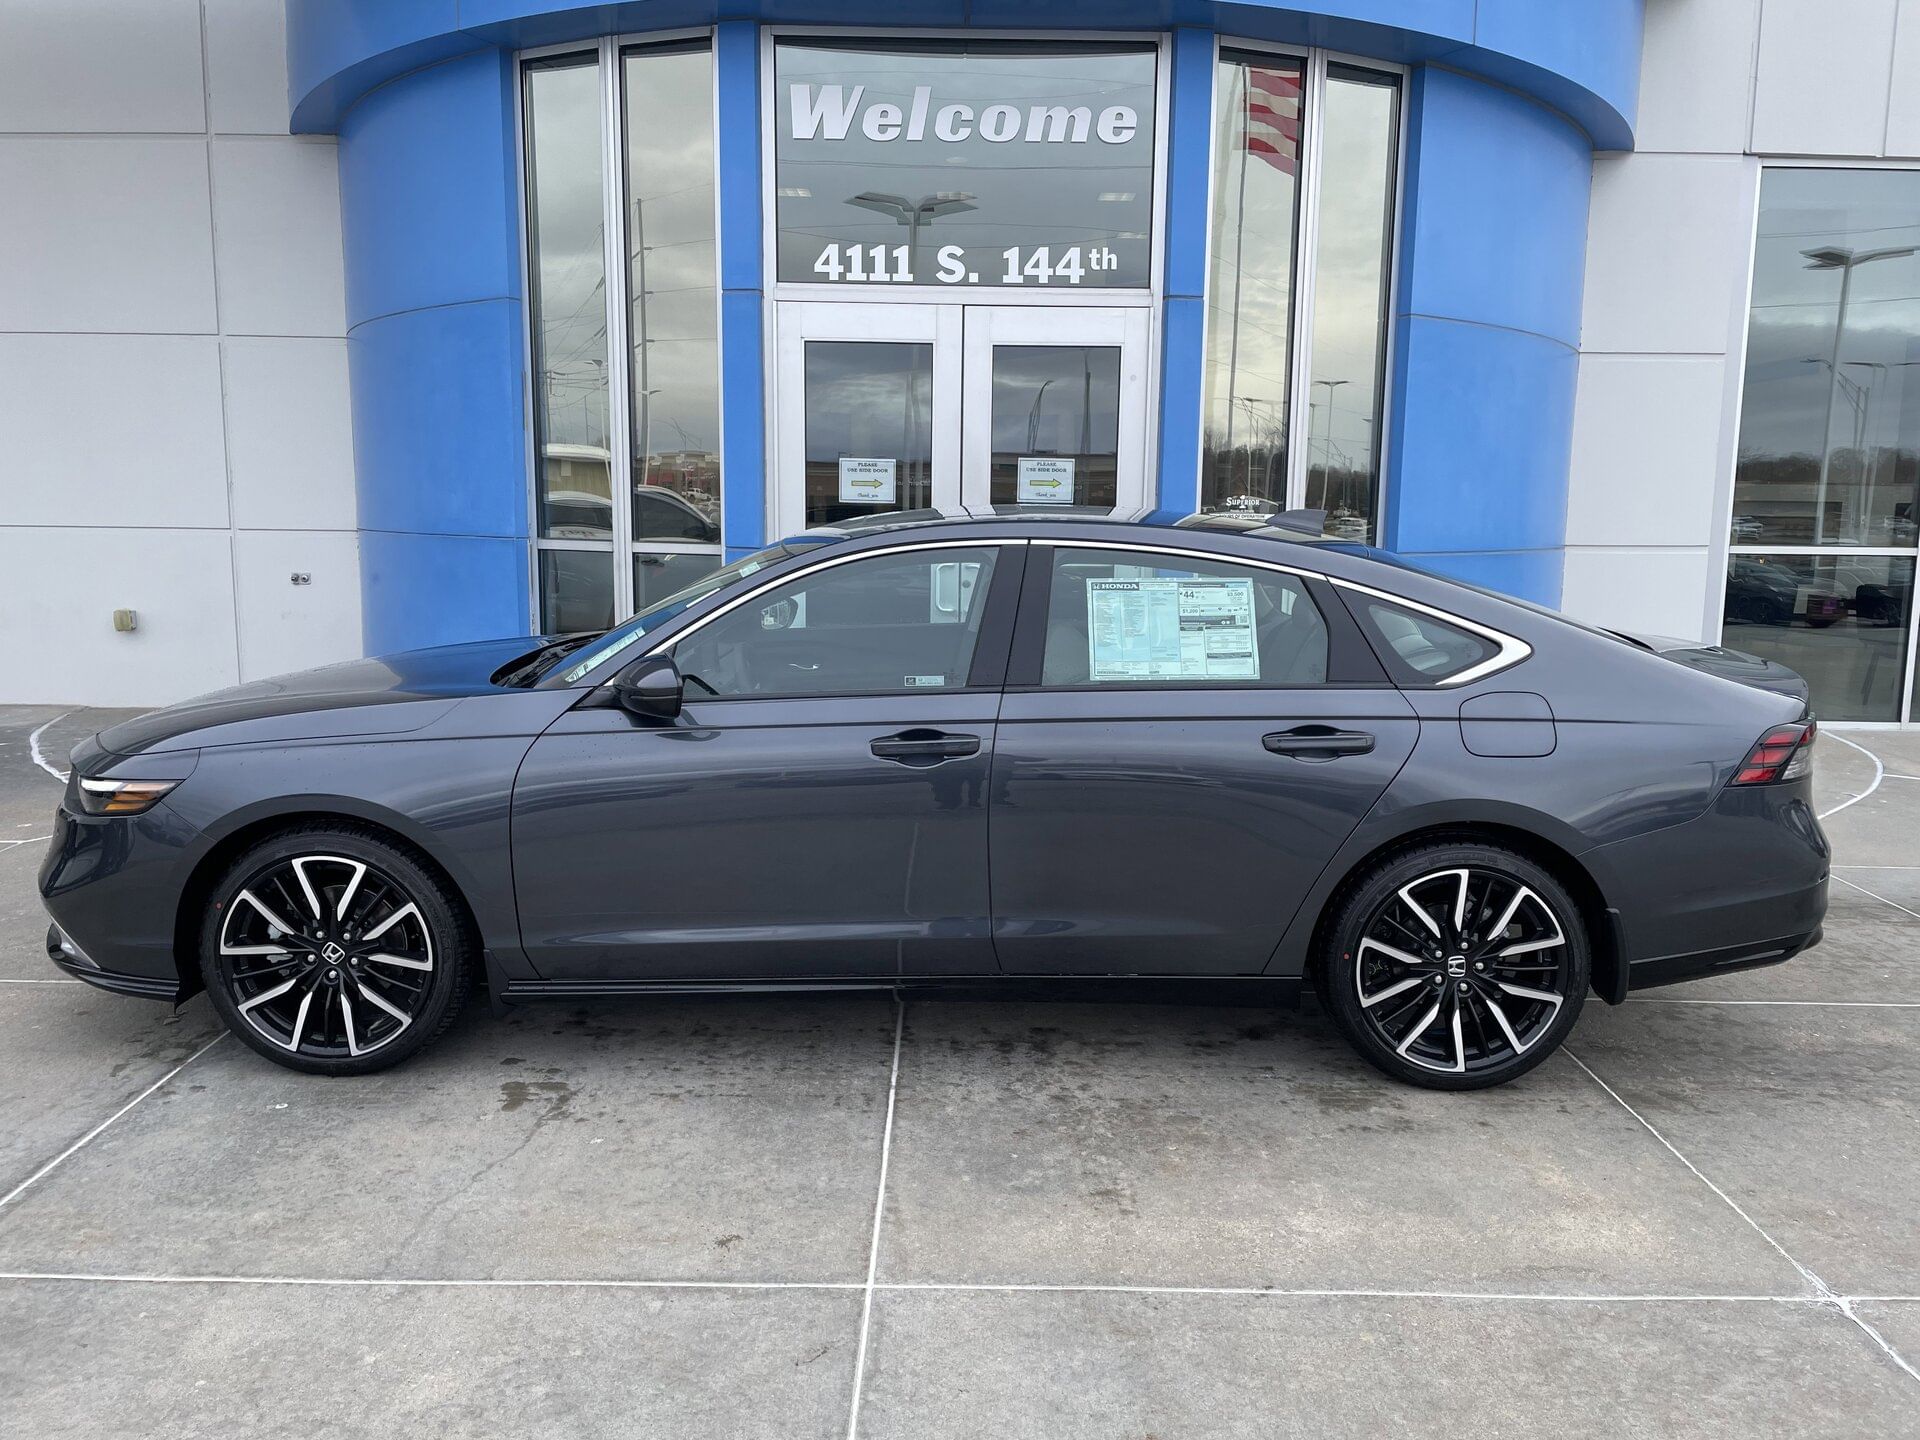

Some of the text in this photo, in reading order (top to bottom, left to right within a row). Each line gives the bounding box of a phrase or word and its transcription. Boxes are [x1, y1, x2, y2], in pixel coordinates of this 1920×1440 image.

[790, 84, 1138, 144] Welcome
[813, 243, 1117, 283] 4111 S. 144th
[1183, 591, 1195, 599] 44
